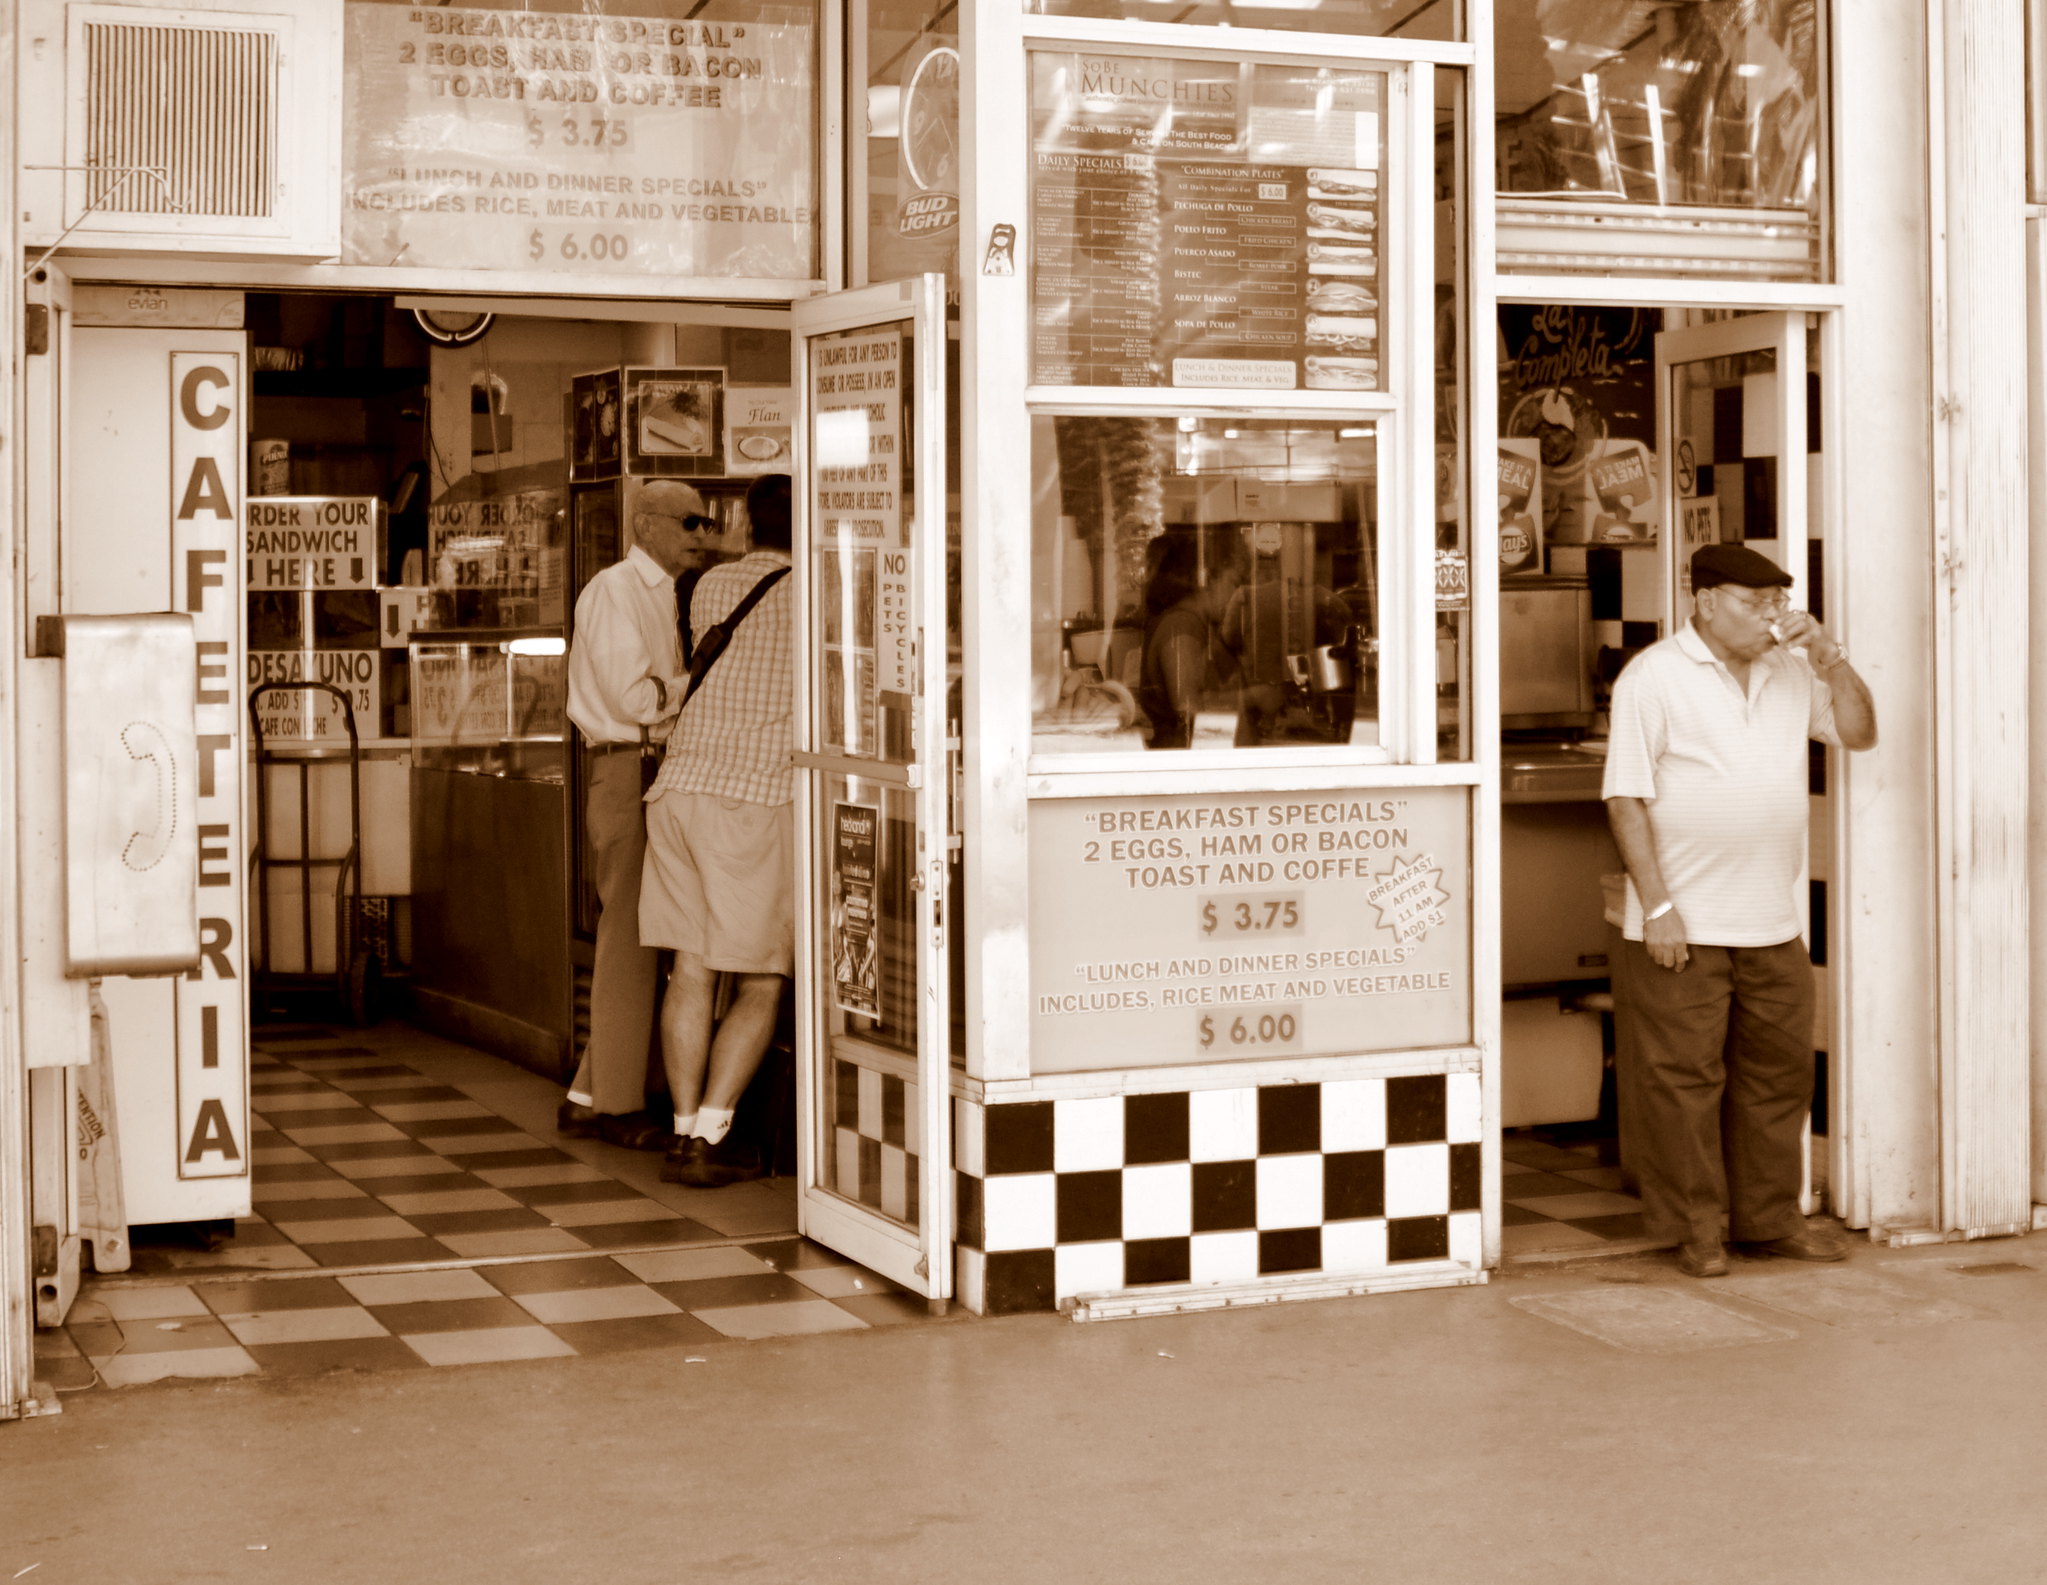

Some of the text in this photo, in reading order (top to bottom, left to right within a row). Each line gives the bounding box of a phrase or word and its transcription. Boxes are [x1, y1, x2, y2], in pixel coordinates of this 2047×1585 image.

[399, 41, 416, 64] 2
[426, 42, 515, 73] EGGS,
[612, 52, 651, 74] OR
[662, 55, 761, 80] BACON
[431, 74, 721, 108] TOAST AND COFFEE
[1081, 74, 1233, 102] MUNCHIES
[528, 116, 627, 149] $ 3.75
[1209, 131, 1232, 141] FOOD
[1038, 153, 1070, 167] DAILY
[1073, 155, 1122, 169] SPECIALS
[490, 171, 538, 190] AND
[548, 173, 632, 193] DINNER
[345, 191, 810, 224] INCLUDES RICE, MEAT AND VEGETABLE
[905, 197, 948, 216] BUD
[1174, 200, 1212, 211] PECHUGA
[1227, 203, 1253, 213] POLLO
[900, 210, 957, 233] LIGHT
[1174, 224, 1227, 235] POLLO FRITO
[528, 228, 628, 262] $ 6.00
[1174, 247, 1236, 257] PUERCO ASADO
[1174, 269, 1202, 279] BISTEC
[1203, 294, 1237, 304] BLANCO
[1174, 319, 1195, 328] SOPA
[1209, 320, 1236, 329] POLLO
[749, 405, 781, 425] Flan
[1498, 459, 1515, 470] AKE
[247, 502, 369, 527] RDER YOUR
[266, 557, 336, 587] HERE
[884, 554, 906, 576] NO
[883, 583, 892, 633] PETS
[895, 583, 906, 688] BICYCLES
[247, 652, 372, 684] DESAUNO
[267, 690, 289, 711] ADD
[177, 365, 241, 1164] CAFETERIA
[1084, 801, 1408, 833] “BREAKFAST SPECIALS”
[1083, 828, 1408, 862] 2 EGGS, HAM OR BACON
[1125, 857, 1370, 889] TOAST AND COFFE
[1368, 856, 1434, 902] BREAKFAST
[1392, 880, 1428, 907] AFTER
[1202, 900, 1299, 935] $ 3.75
[1398, 896, 1434, 923] 11 AM
[1402, 909, 1444, 940] ADD $1
[1076, 946, 1416, 982] “LUNCH AND DINNER SPECIALS”
[1039, 972, 1450, 1013] INCLUDES, RICE MEAT AND VEGETABLE
[1200, 1013, 1296, 1050] $ 6.00
